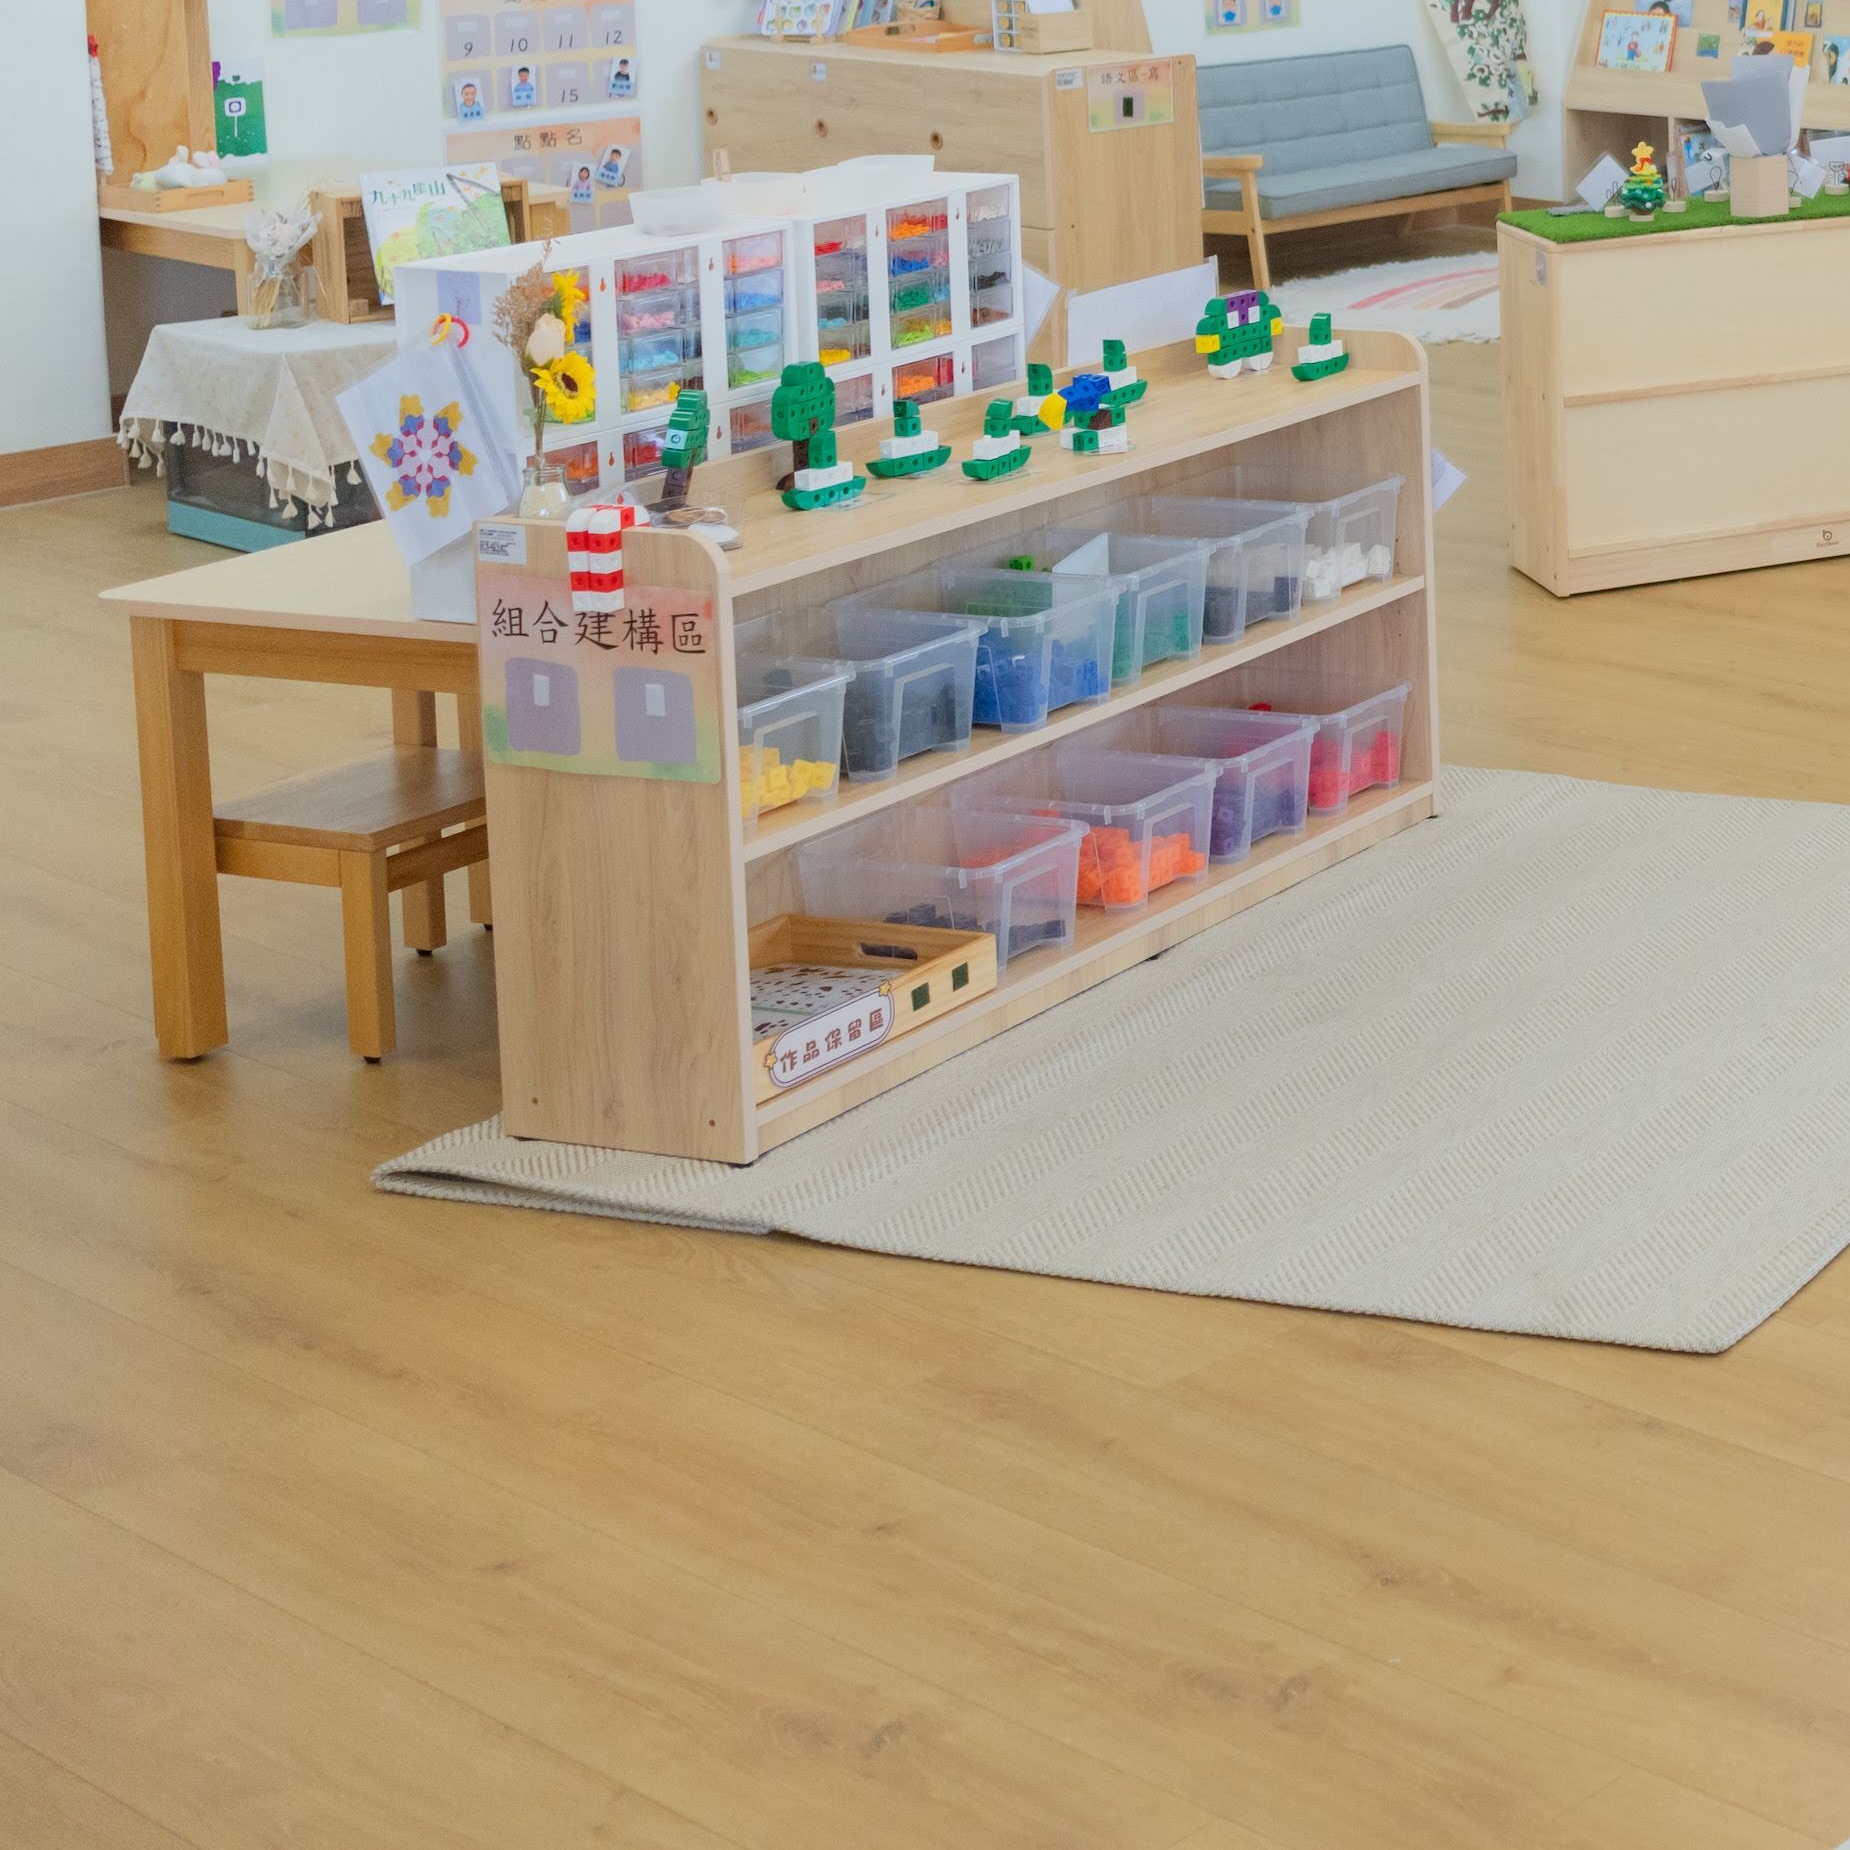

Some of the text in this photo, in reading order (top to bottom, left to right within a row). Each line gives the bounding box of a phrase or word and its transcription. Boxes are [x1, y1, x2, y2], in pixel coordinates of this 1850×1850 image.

[510, 37, 528, 53] 10
[558, 33, 574, 49] 11
[605, 29, 623, 45] 12
[464, 41, 473, 56] 9
[561, 88, 579, 104] 15
[513, 128, 582, 150] 點點名
[491, 598, 707, 655] 組合建構區
[779, 1007, 885, 1074] 作品保留區
